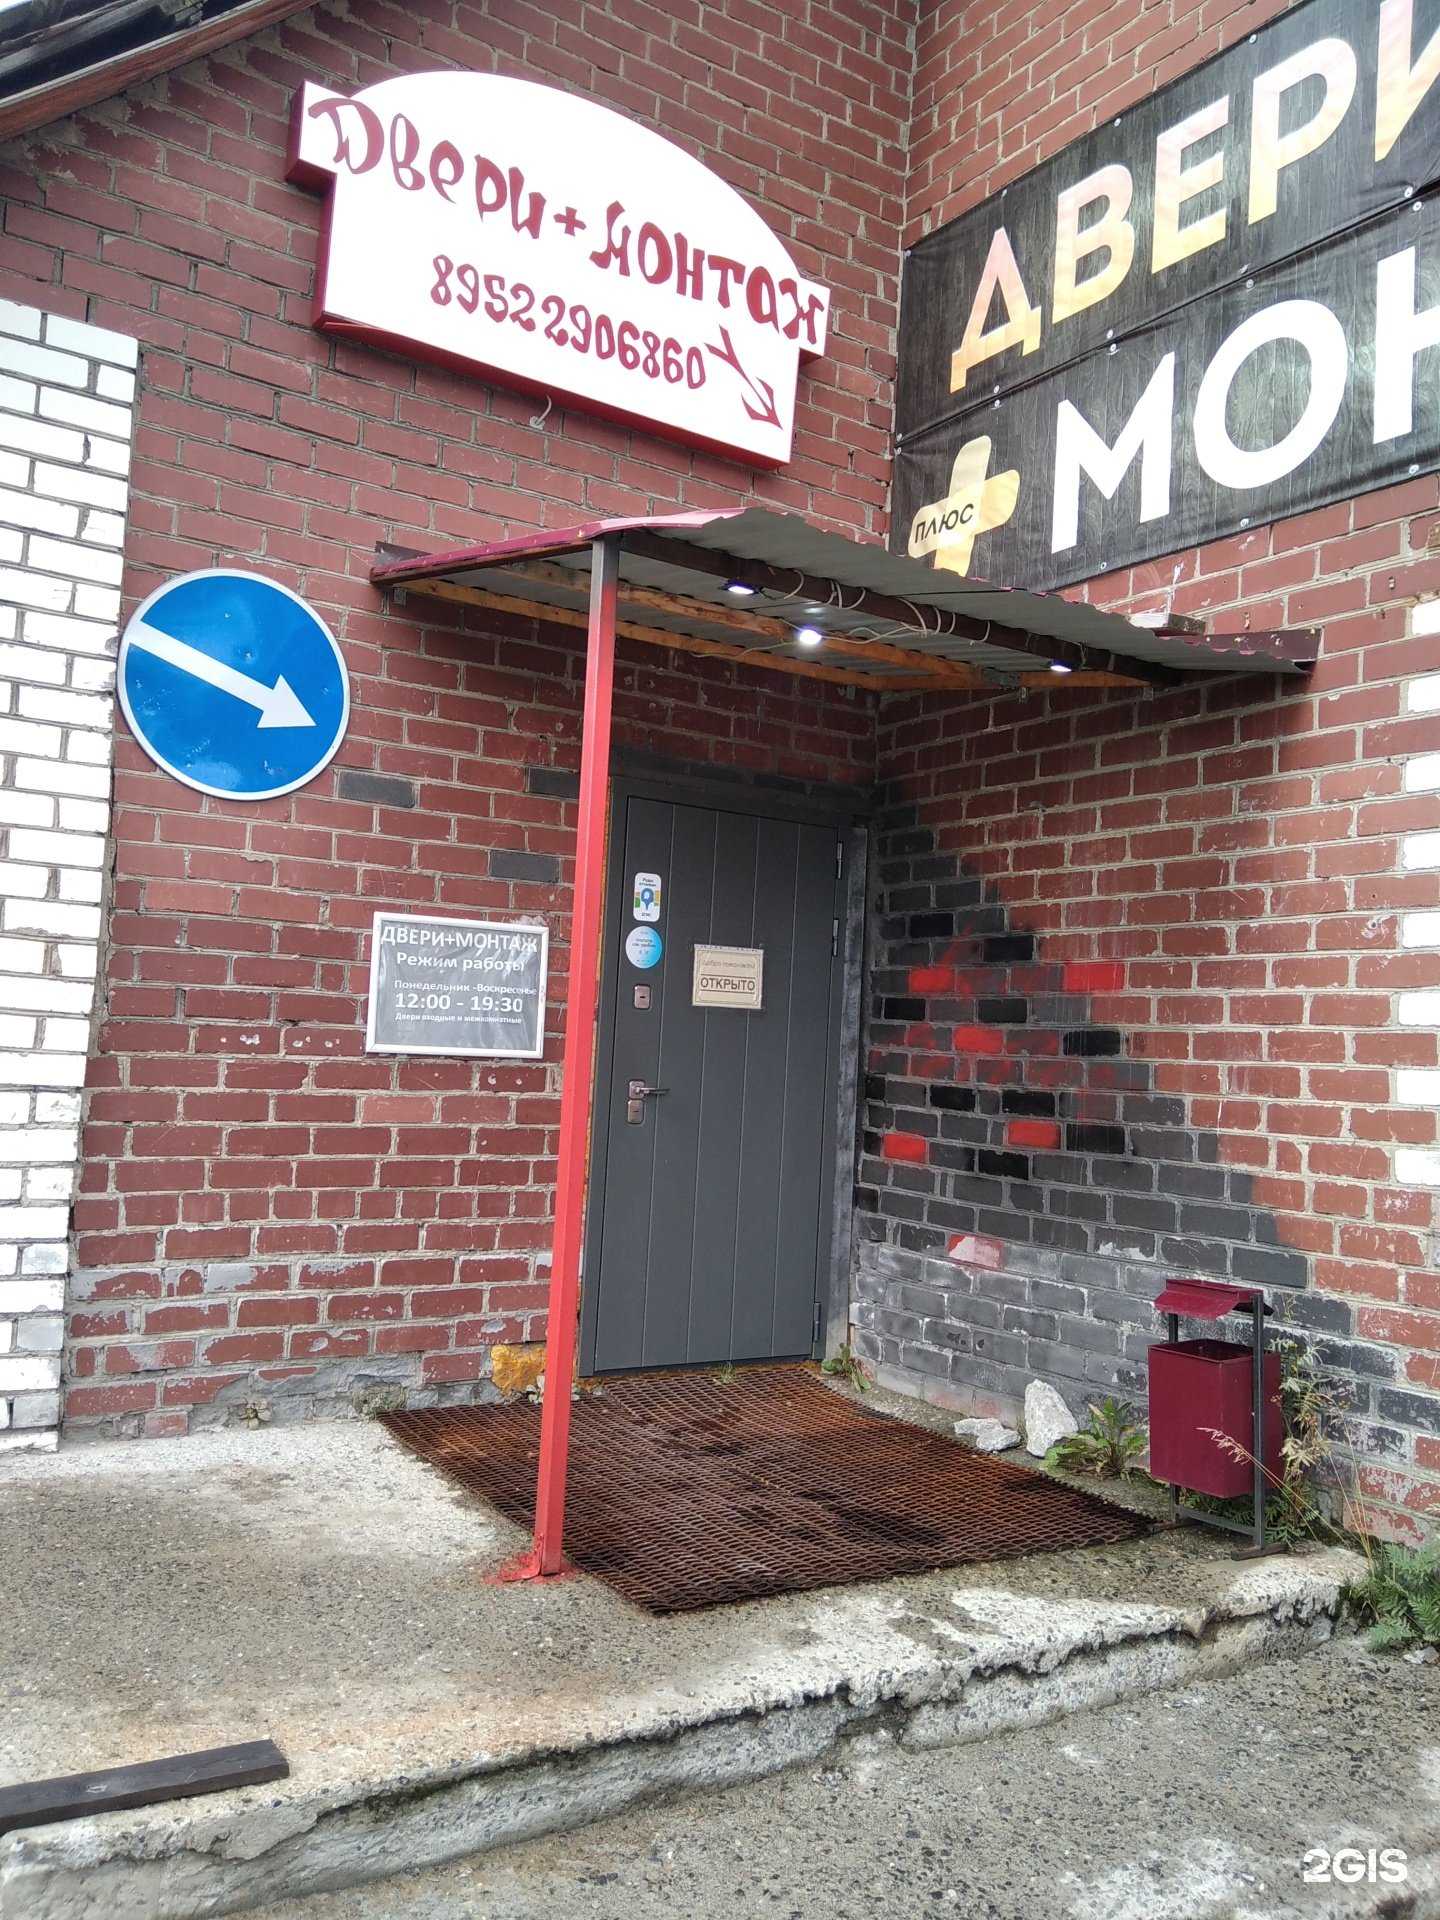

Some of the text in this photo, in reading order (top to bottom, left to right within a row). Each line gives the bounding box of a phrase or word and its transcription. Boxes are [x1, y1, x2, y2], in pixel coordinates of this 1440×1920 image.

[430, 254, 706, 389] 89522906860
[914, 503, 974, 544] ПЛЮС
[396, 952, 525, 971] Режим работы
[394, 979, 470, 992] Понедельник
[700, 977, 755, 991] ОТКРЫТО
[395, 993, 451, 1010] 12:00
[470, 996, 523, 1013] 19:30
[395, 1012, 421, 1022] Двери
